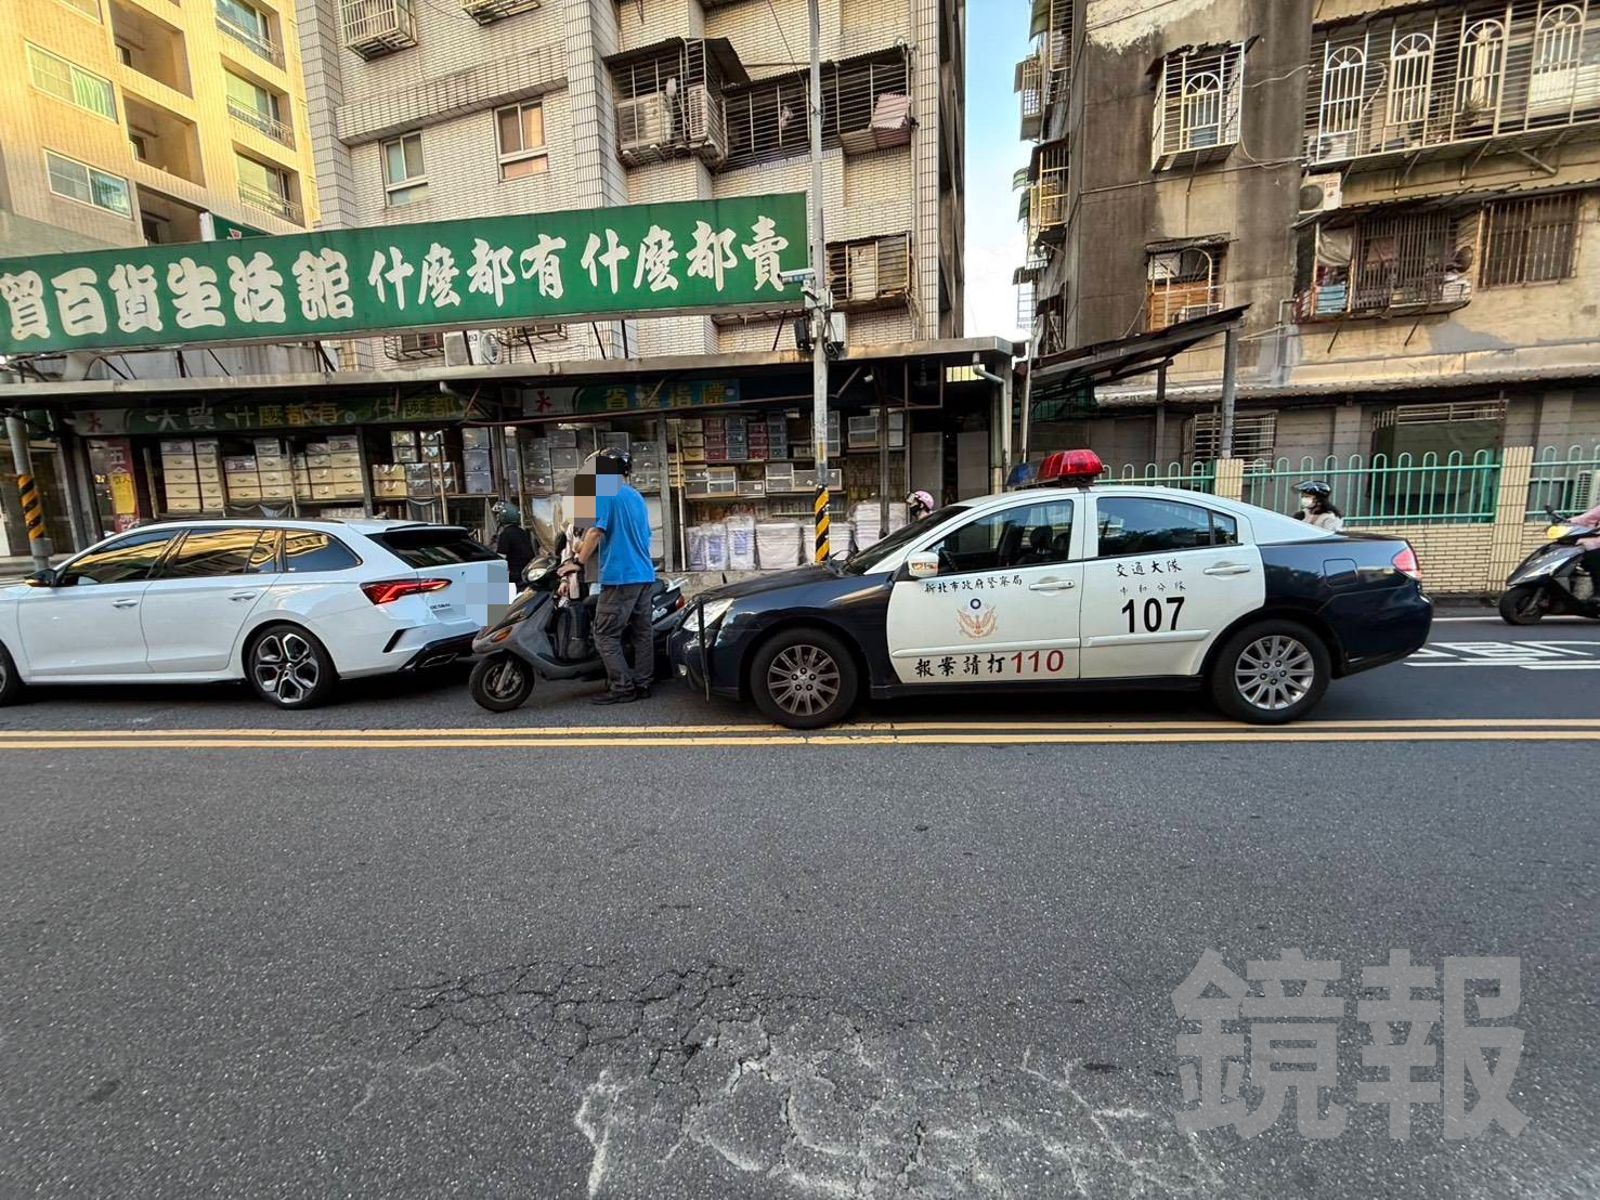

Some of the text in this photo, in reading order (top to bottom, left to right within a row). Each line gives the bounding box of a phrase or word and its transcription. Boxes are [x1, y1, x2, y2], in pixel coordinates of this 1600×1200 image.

[368, 232, 567, 311] 什麼都有
[580, 214, 790, 294] 什麼都賣
[1116, 558, 1182, 577] 交通大隊
[924, 574, 1023, 594] 新北市政府警察局
[1121, 596, 1185, 634] 107
[914, 649, 1065, 678] 報案請打110
